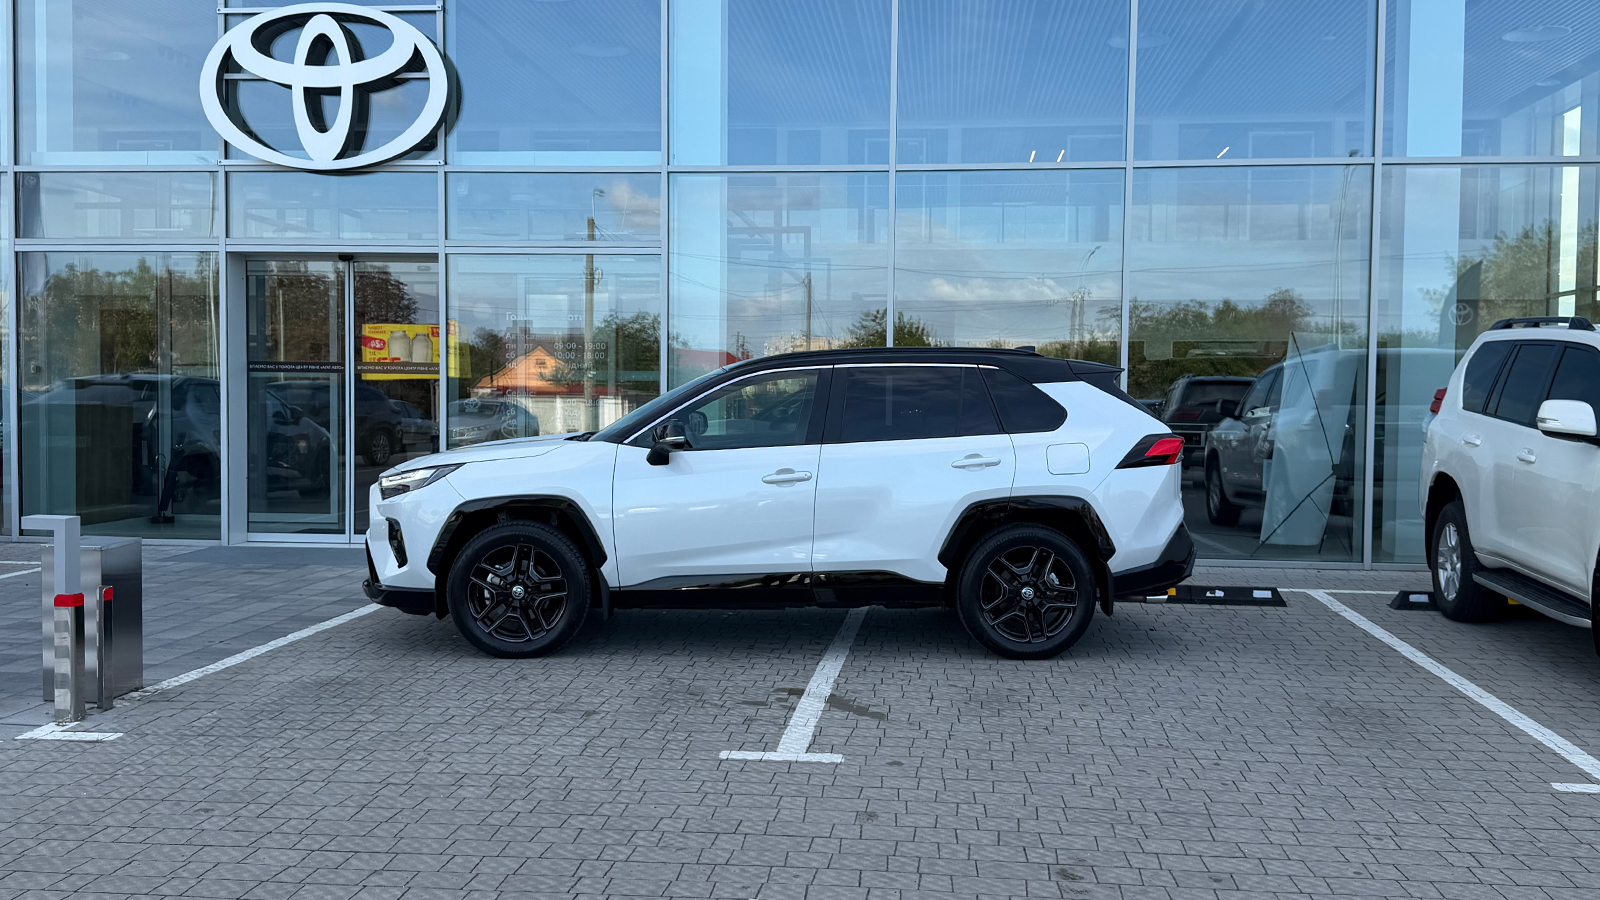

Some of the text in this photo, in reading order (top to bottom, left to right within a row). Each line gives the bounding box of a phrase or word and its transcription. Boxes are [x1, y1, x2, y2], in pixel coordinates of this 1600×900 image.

[553, 342, 577, 350] 09:00
[584, 342, 606, 350] 19:00
[505, 350, 516, 359] сб
[554, 351, 576, 359] 10:00
[583, 351, 605, 359] 18:00
[506, 407, 516, 415] сб
